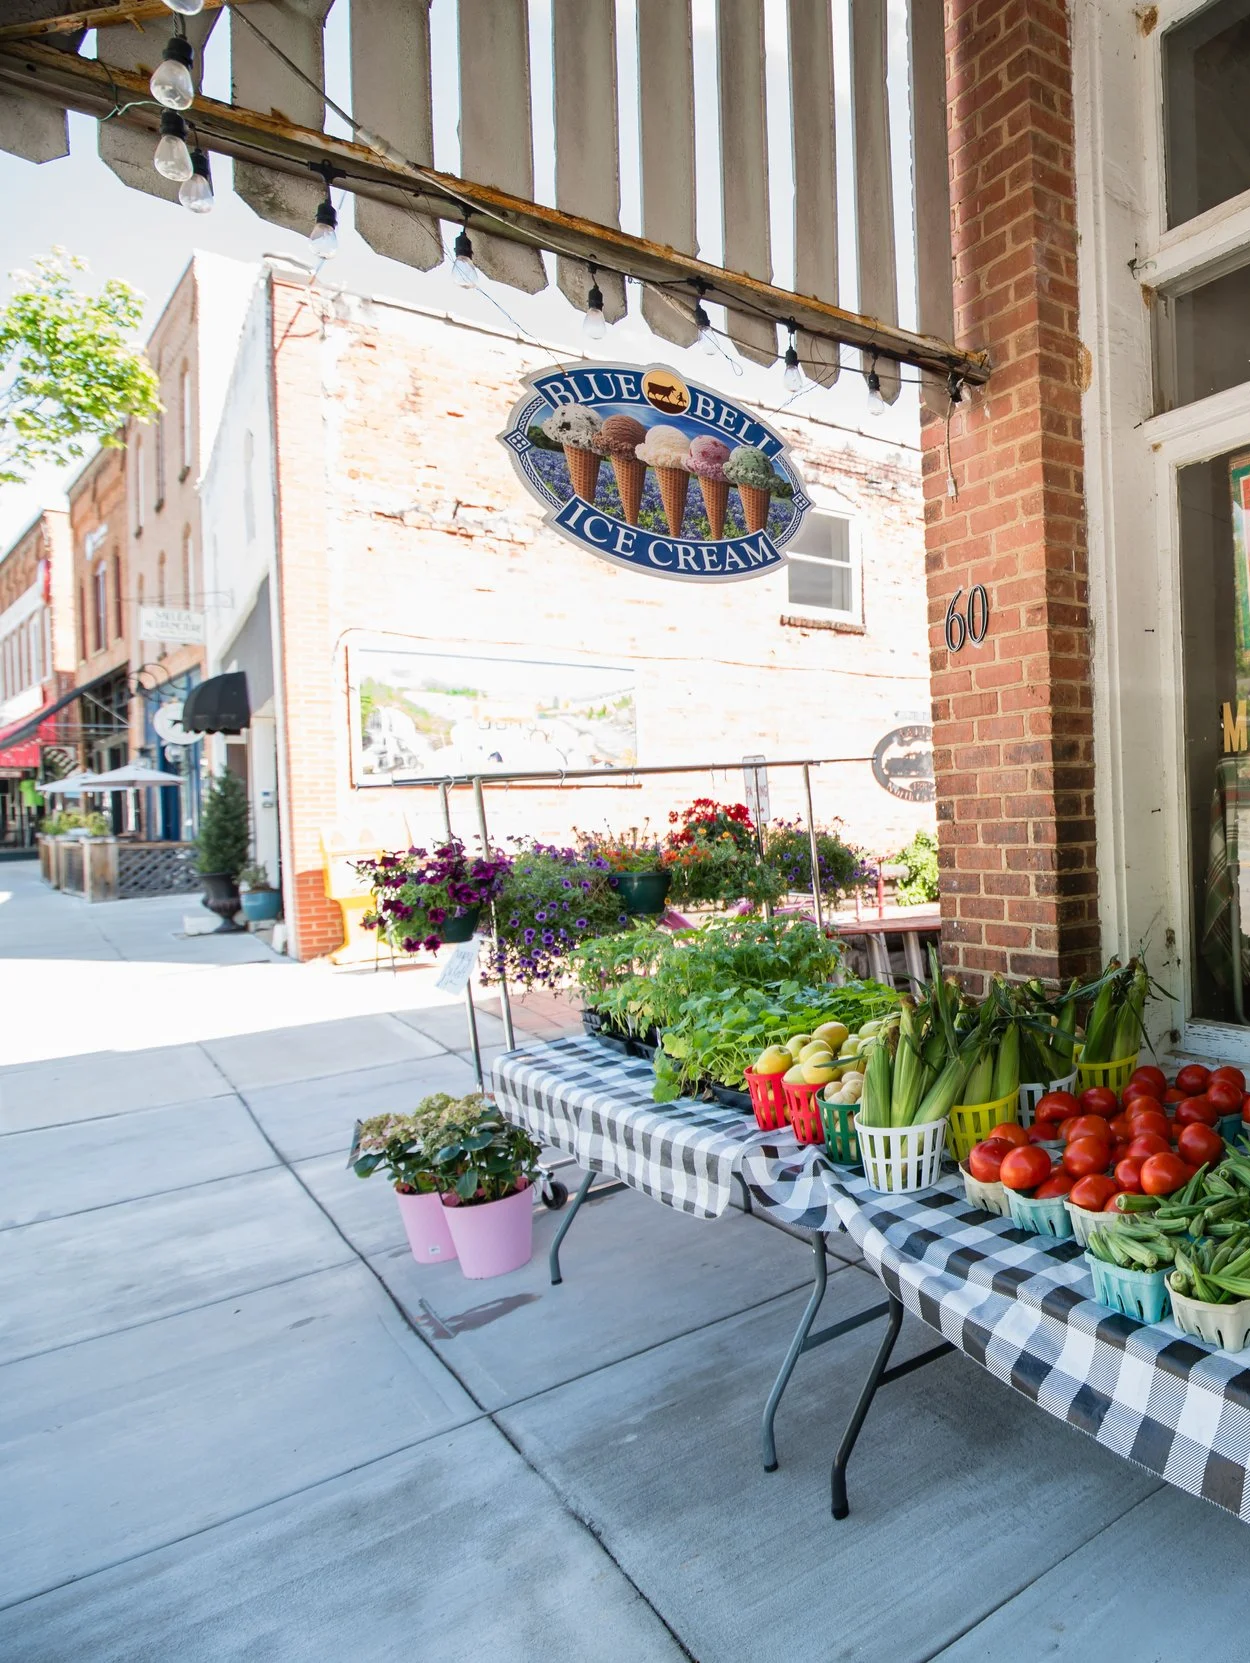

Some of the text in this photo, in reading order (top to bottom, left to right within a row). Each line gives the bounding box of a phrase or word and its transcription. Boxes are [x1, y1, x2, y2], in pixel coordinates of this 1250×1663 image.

[541, 373, 641, 407] BLUE
[564, 502, 777, 572] ICE CREAM
[945, 585, 988, 652] 60
